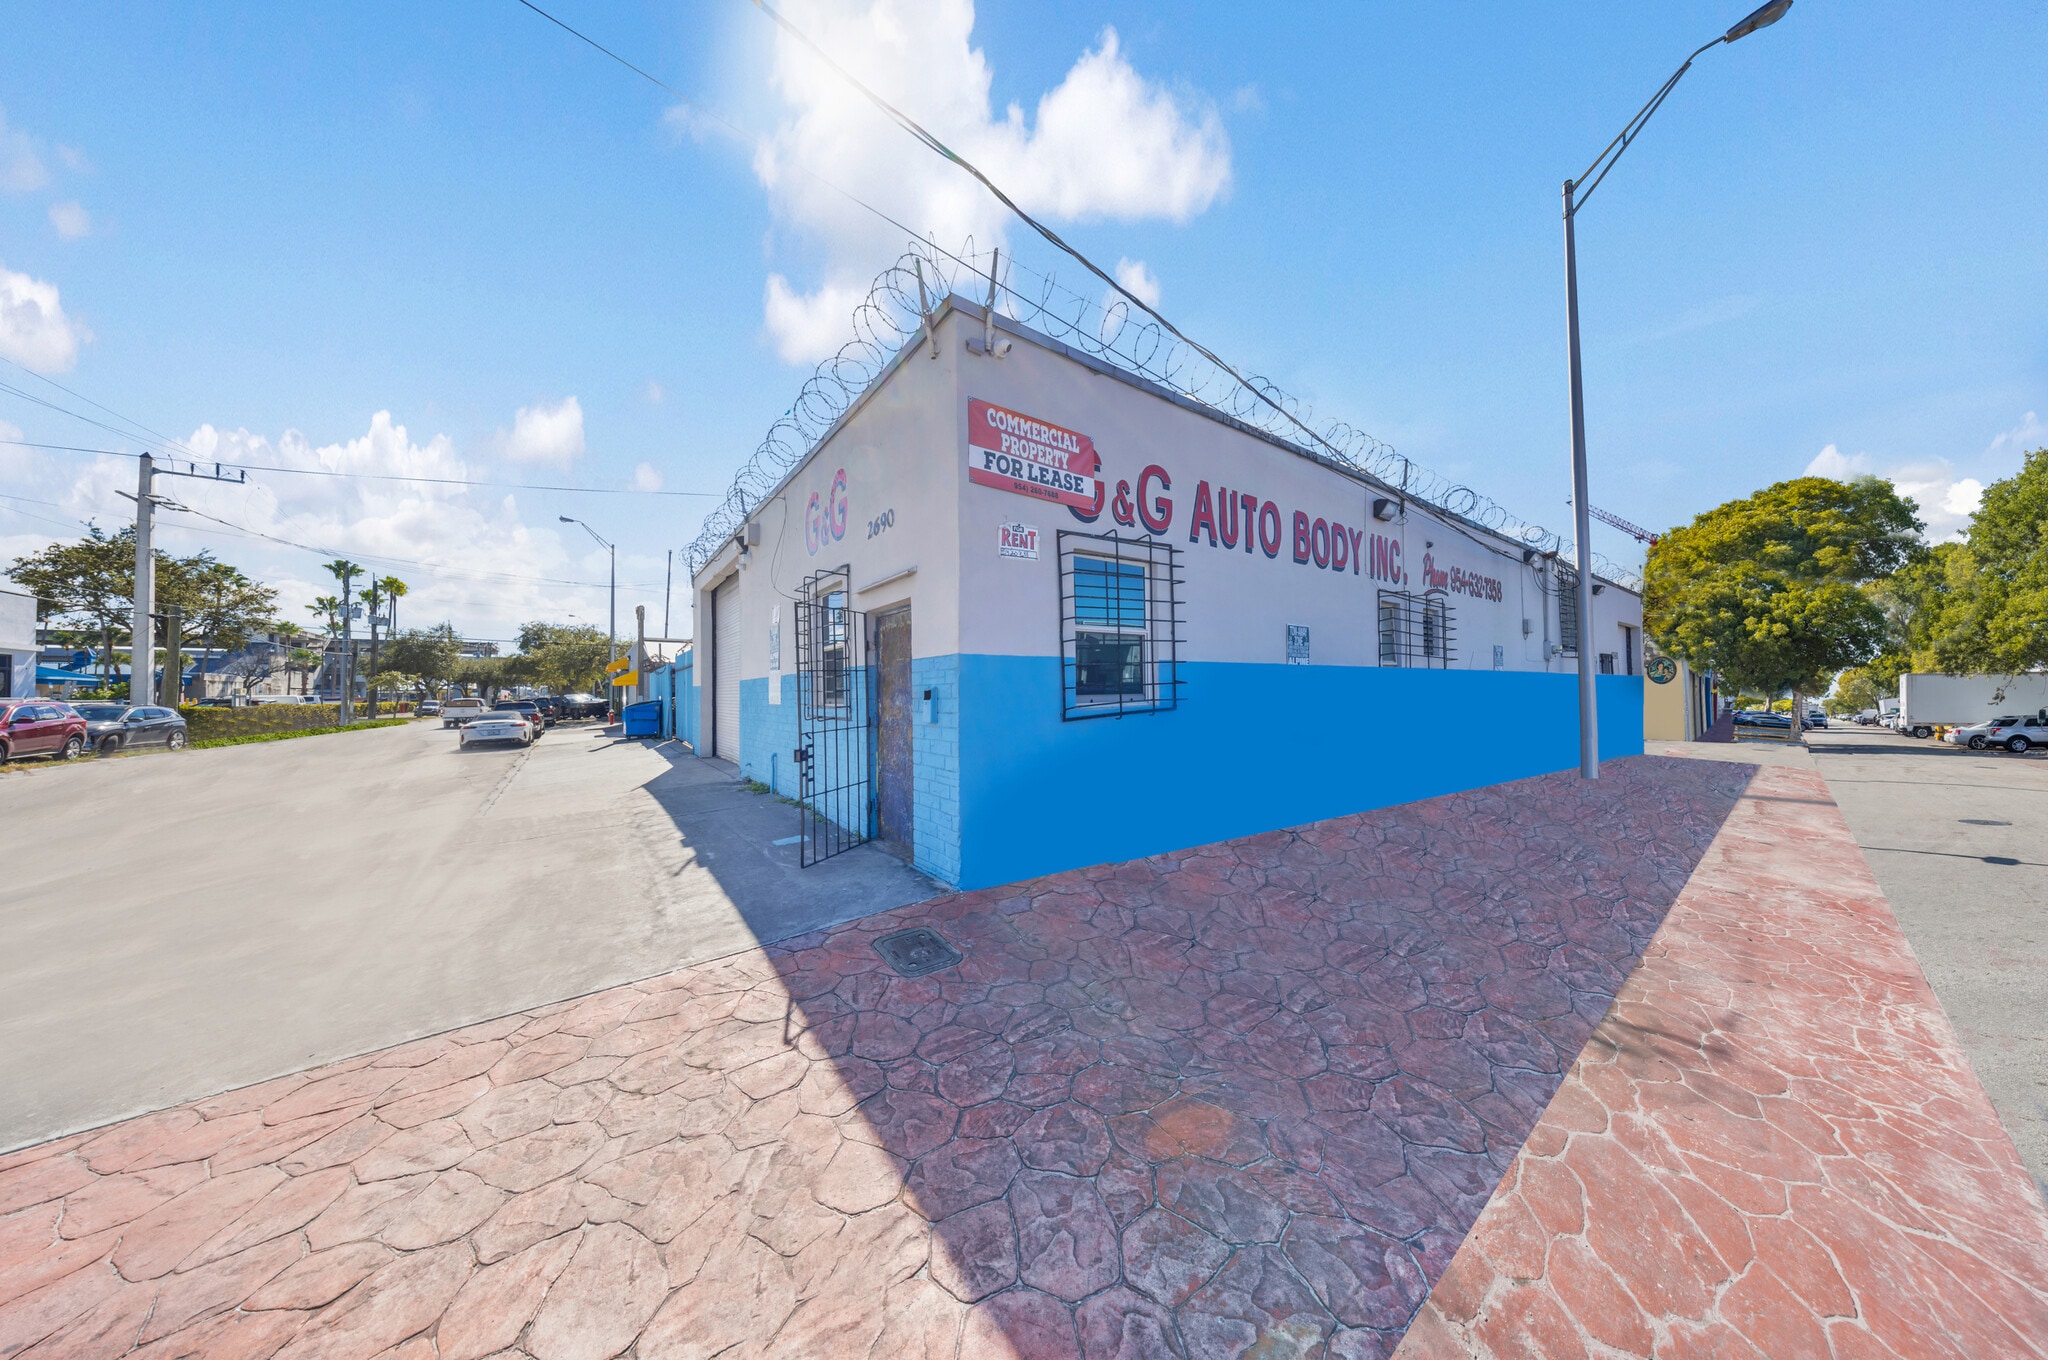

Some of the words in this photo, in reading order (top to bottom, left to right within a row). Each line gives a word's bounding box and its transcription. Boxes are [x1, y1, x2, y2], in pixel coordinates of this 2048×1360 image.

[986, 408, 1080, 453] COMMERCIAL
[1001, 433, 1069, 469] PROPERTY
[984, 450, 1023, 479] FOR
[1027, 463, 1084, 493] LEASE
[867, 508, 895, 540] 2690
[1001, 527, 1037, 550] RENT
[1189, 480, 1282, 559] AUTO
[1293, 510, 1363, 575] BODY
[1369, 533, 1408, 585] INC.
